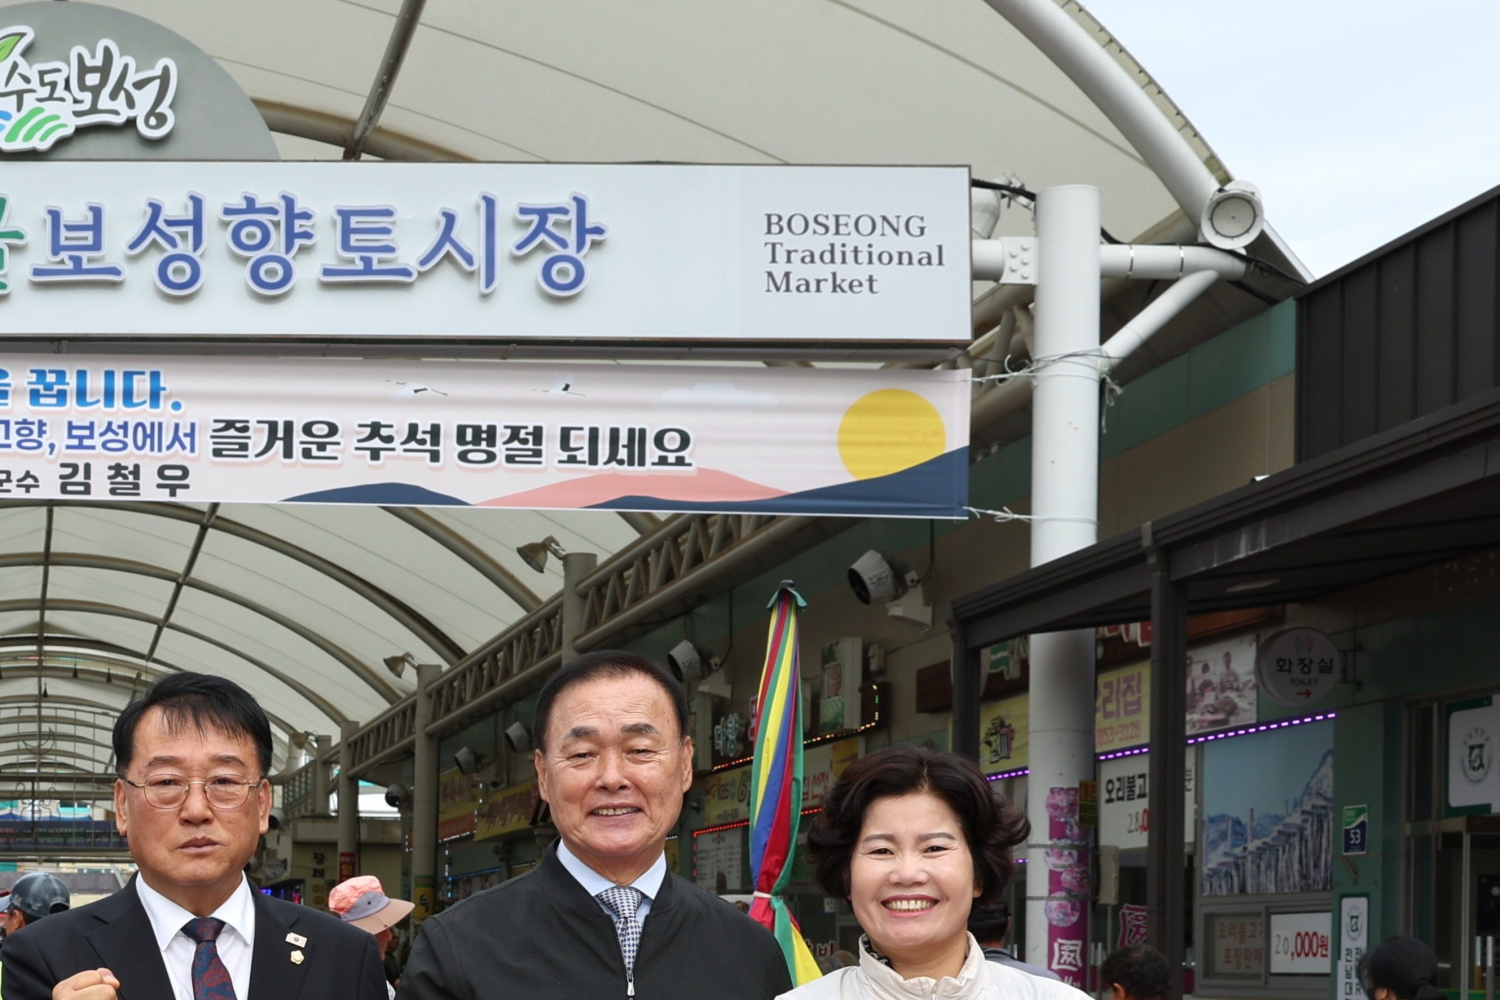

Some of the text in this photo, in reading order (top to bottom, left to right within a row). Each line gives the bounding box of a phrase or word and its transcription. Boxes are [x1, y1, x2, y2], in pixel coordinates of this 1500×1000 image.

[764, 213, 927, 237] BOSEONG
[764, 242, 946, 267] Traditional
[764, 270, 879, 294] Market
[27, 369, 185, 412] 꿉니다.
[64, 420, 198, 455] 보성에서
[210, 419, 342, 462] 즐거운
[354, 422, 443, 464] 추석
[456, 424, 545, 467] 명절
[558, 426, 694, 470] 되세요
[1275, 657, 1334, 675] 화장실
[1289, 677, 1319, 687] TOILET
[1095, 672, 1142, 720] 리집
[1349, 828, 1361, 844] 53
